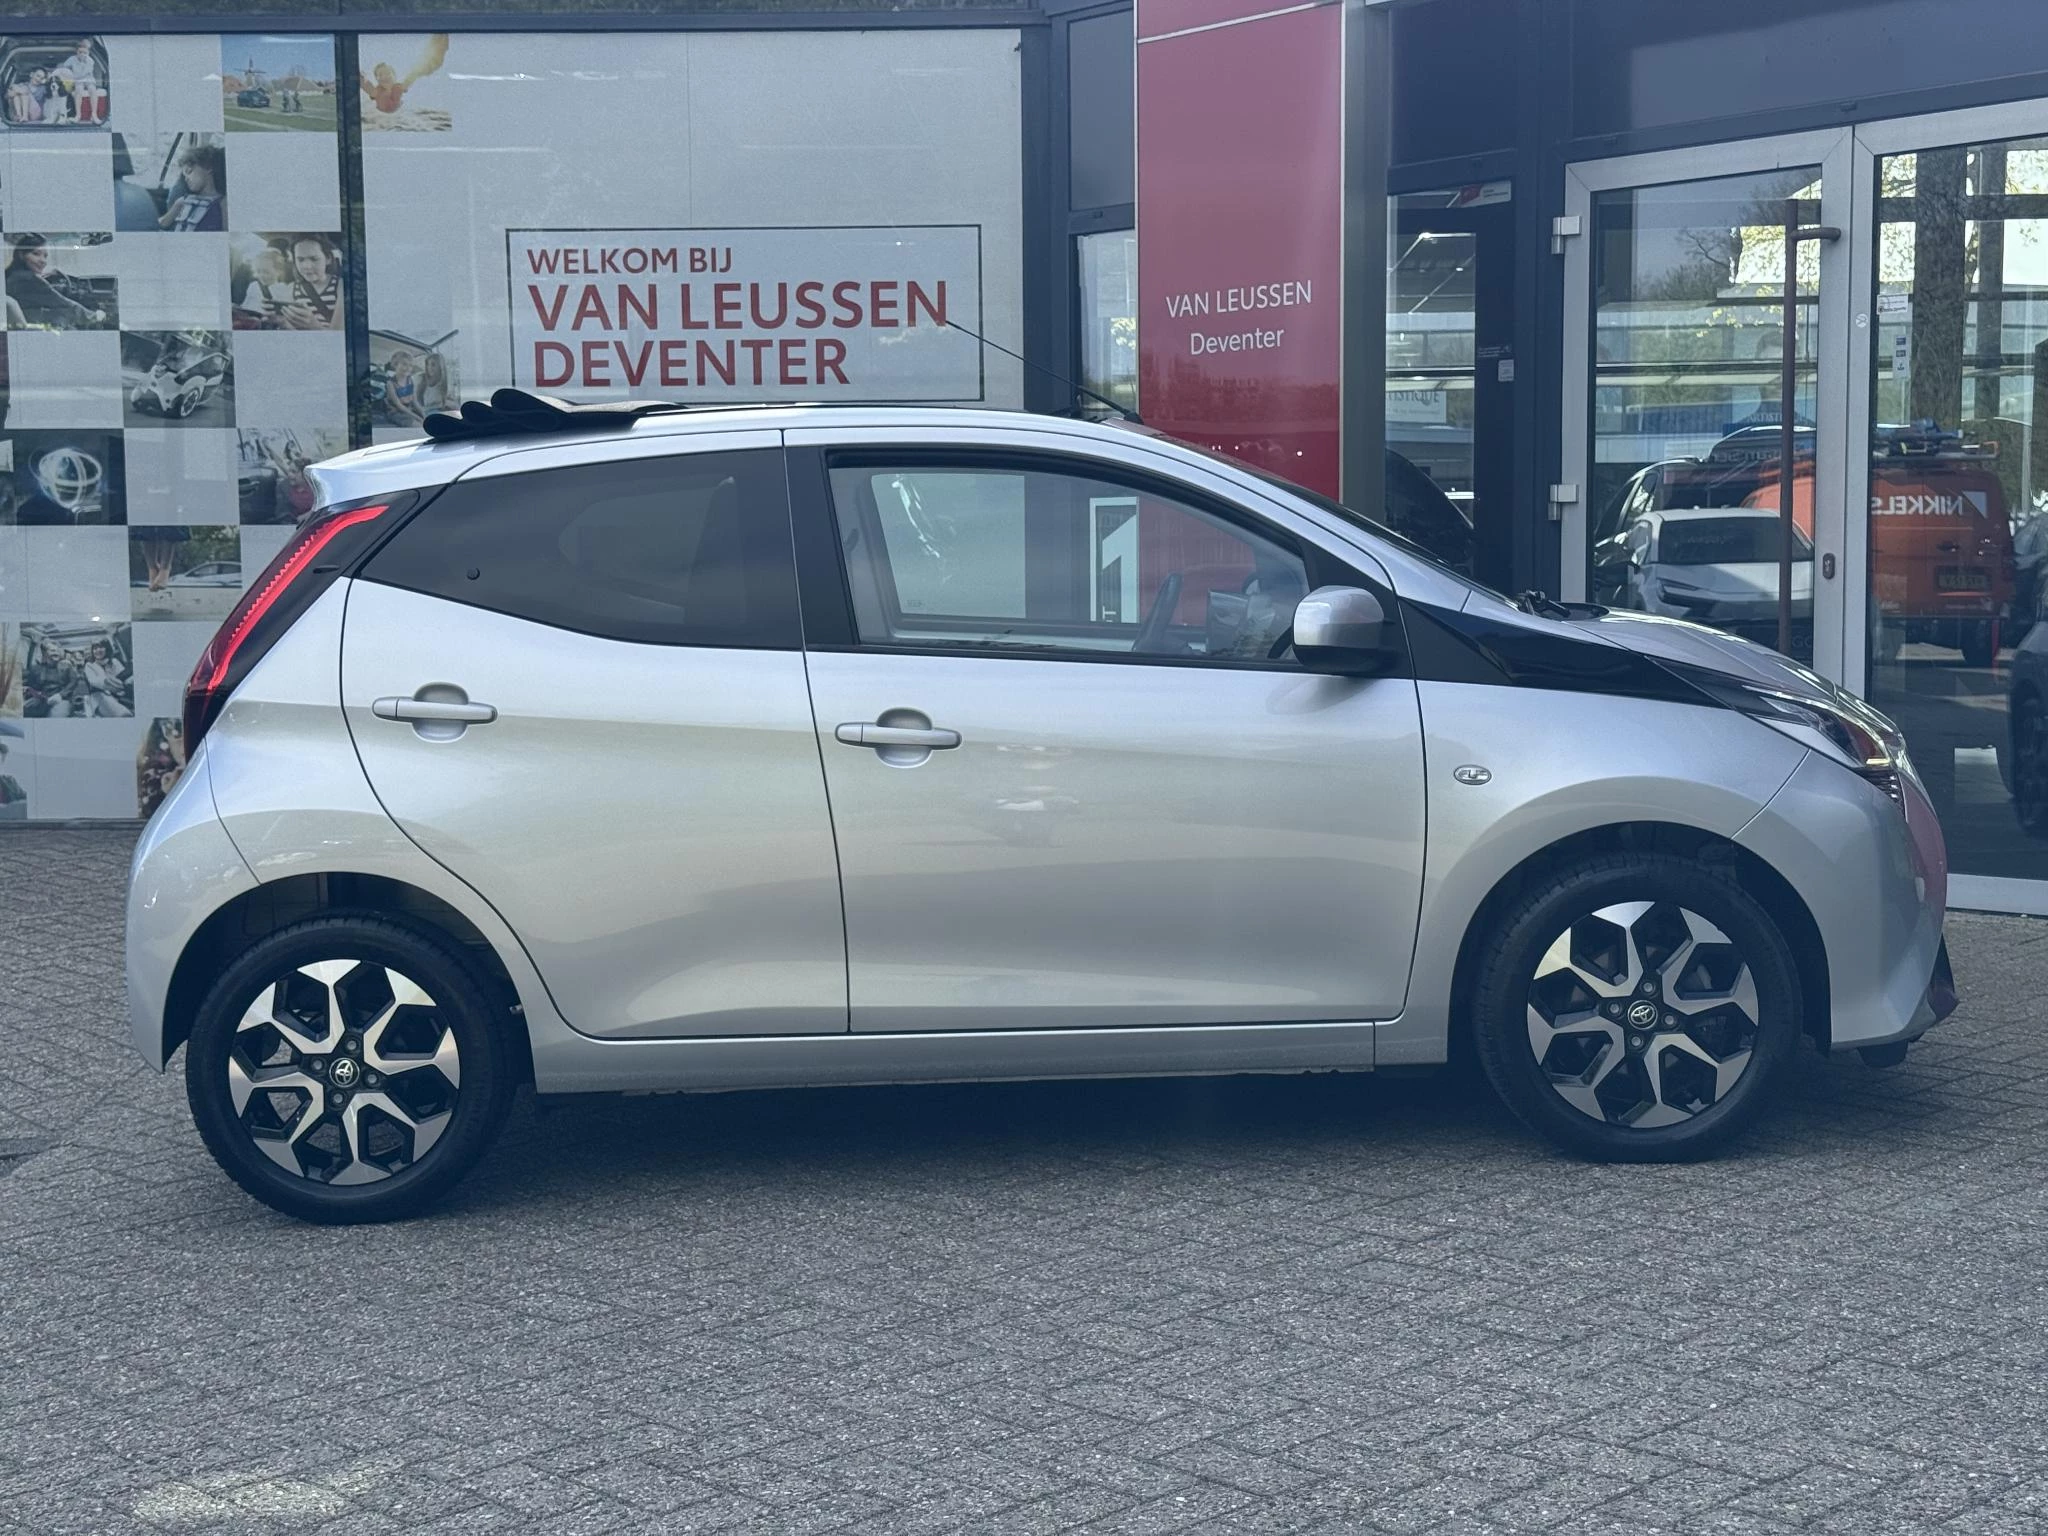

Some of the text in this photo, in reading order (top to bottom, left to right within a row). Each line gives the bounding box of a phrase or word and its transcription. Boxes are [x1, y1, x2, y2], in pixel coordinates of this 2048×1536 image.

[527, 247, 733, 275] WELKOM BIJ
[527, 280, 947, 331] VAN LEUSSEN
[1165, 279, 1312, 319] VAN LEUSSEN
[1190, 327, 1285, 355] Deventer
[534, 338, 851, 388] DEVENTER
